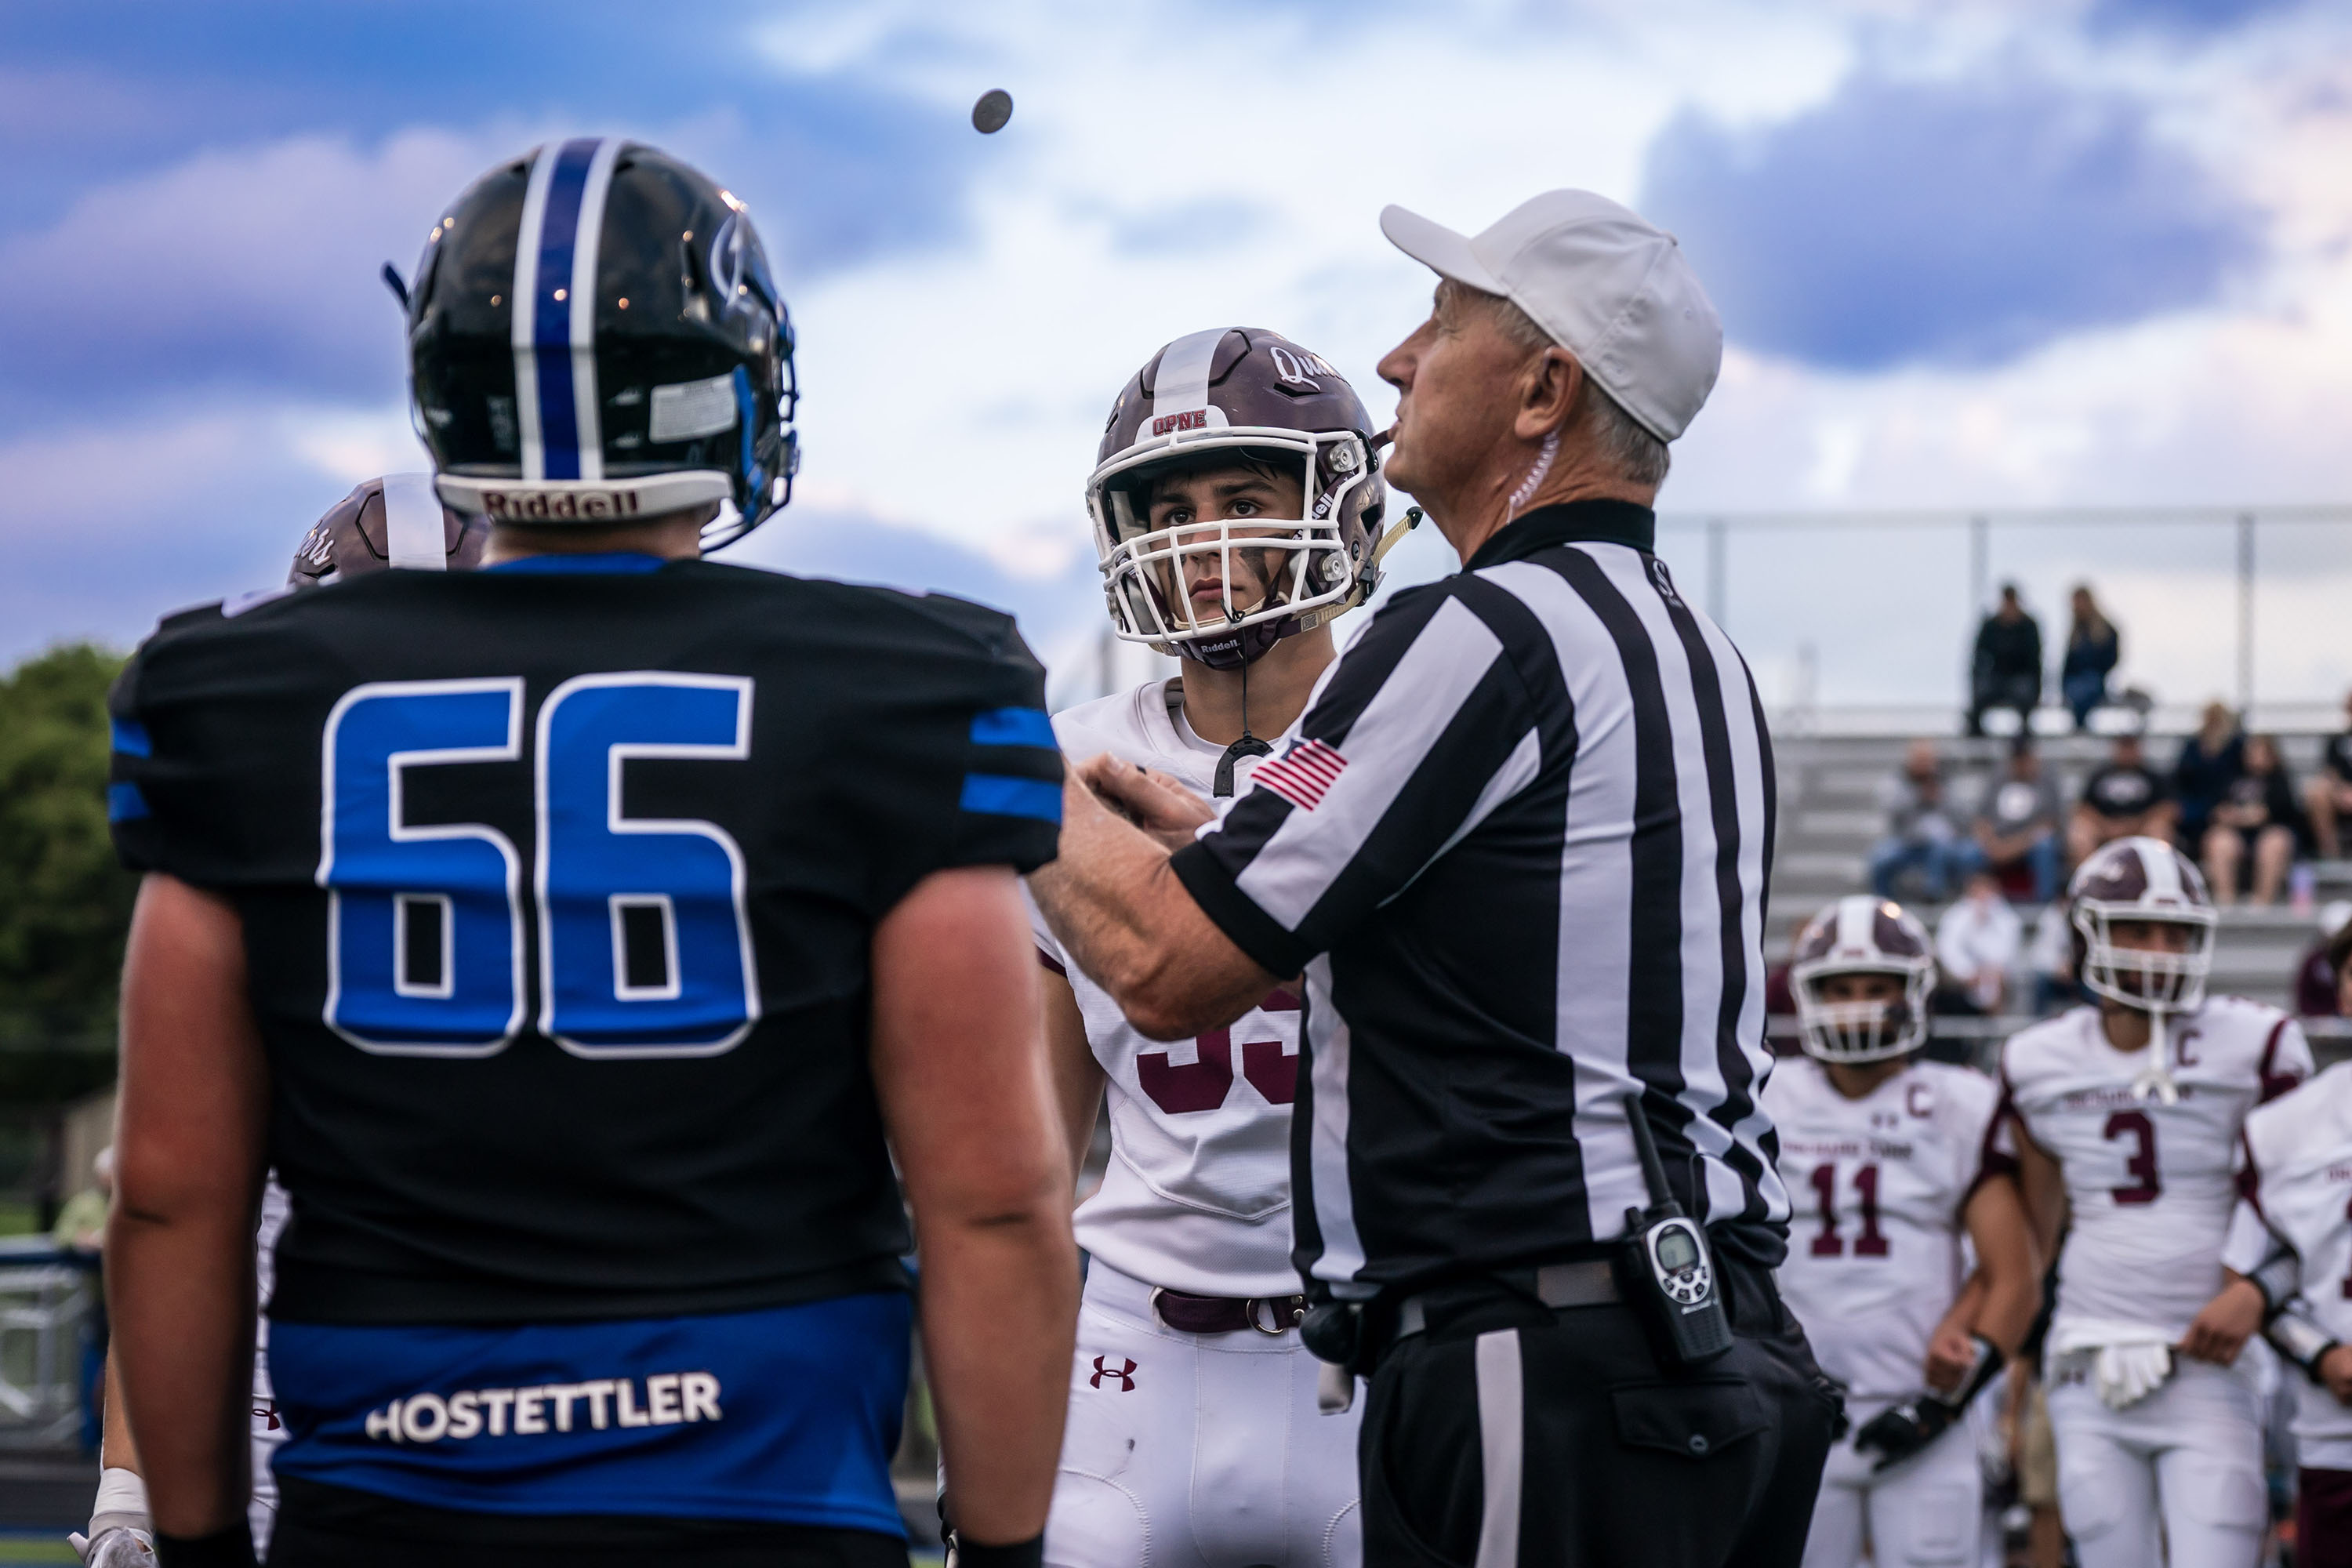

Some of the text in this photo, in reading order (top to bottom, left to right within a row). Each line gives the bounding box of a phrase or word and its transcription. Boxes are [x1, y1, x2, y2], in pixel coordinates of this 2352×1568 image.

[1152, 408, 1207, 437] OPNE
[481, 490, 639, 519] Riddell
[1200, 639, 1239, 653] Riddell
[314, 670, 762, 1061] 66
[2176, 1028, 2201, 1067] C
[1905, 1082, 1933, 1119] C
[2103, 1109, 2164, 1204] 3
[1808, 1162, 1891, 1258] 11
[365, 1370, 723, 1443] HOSTETTLER
